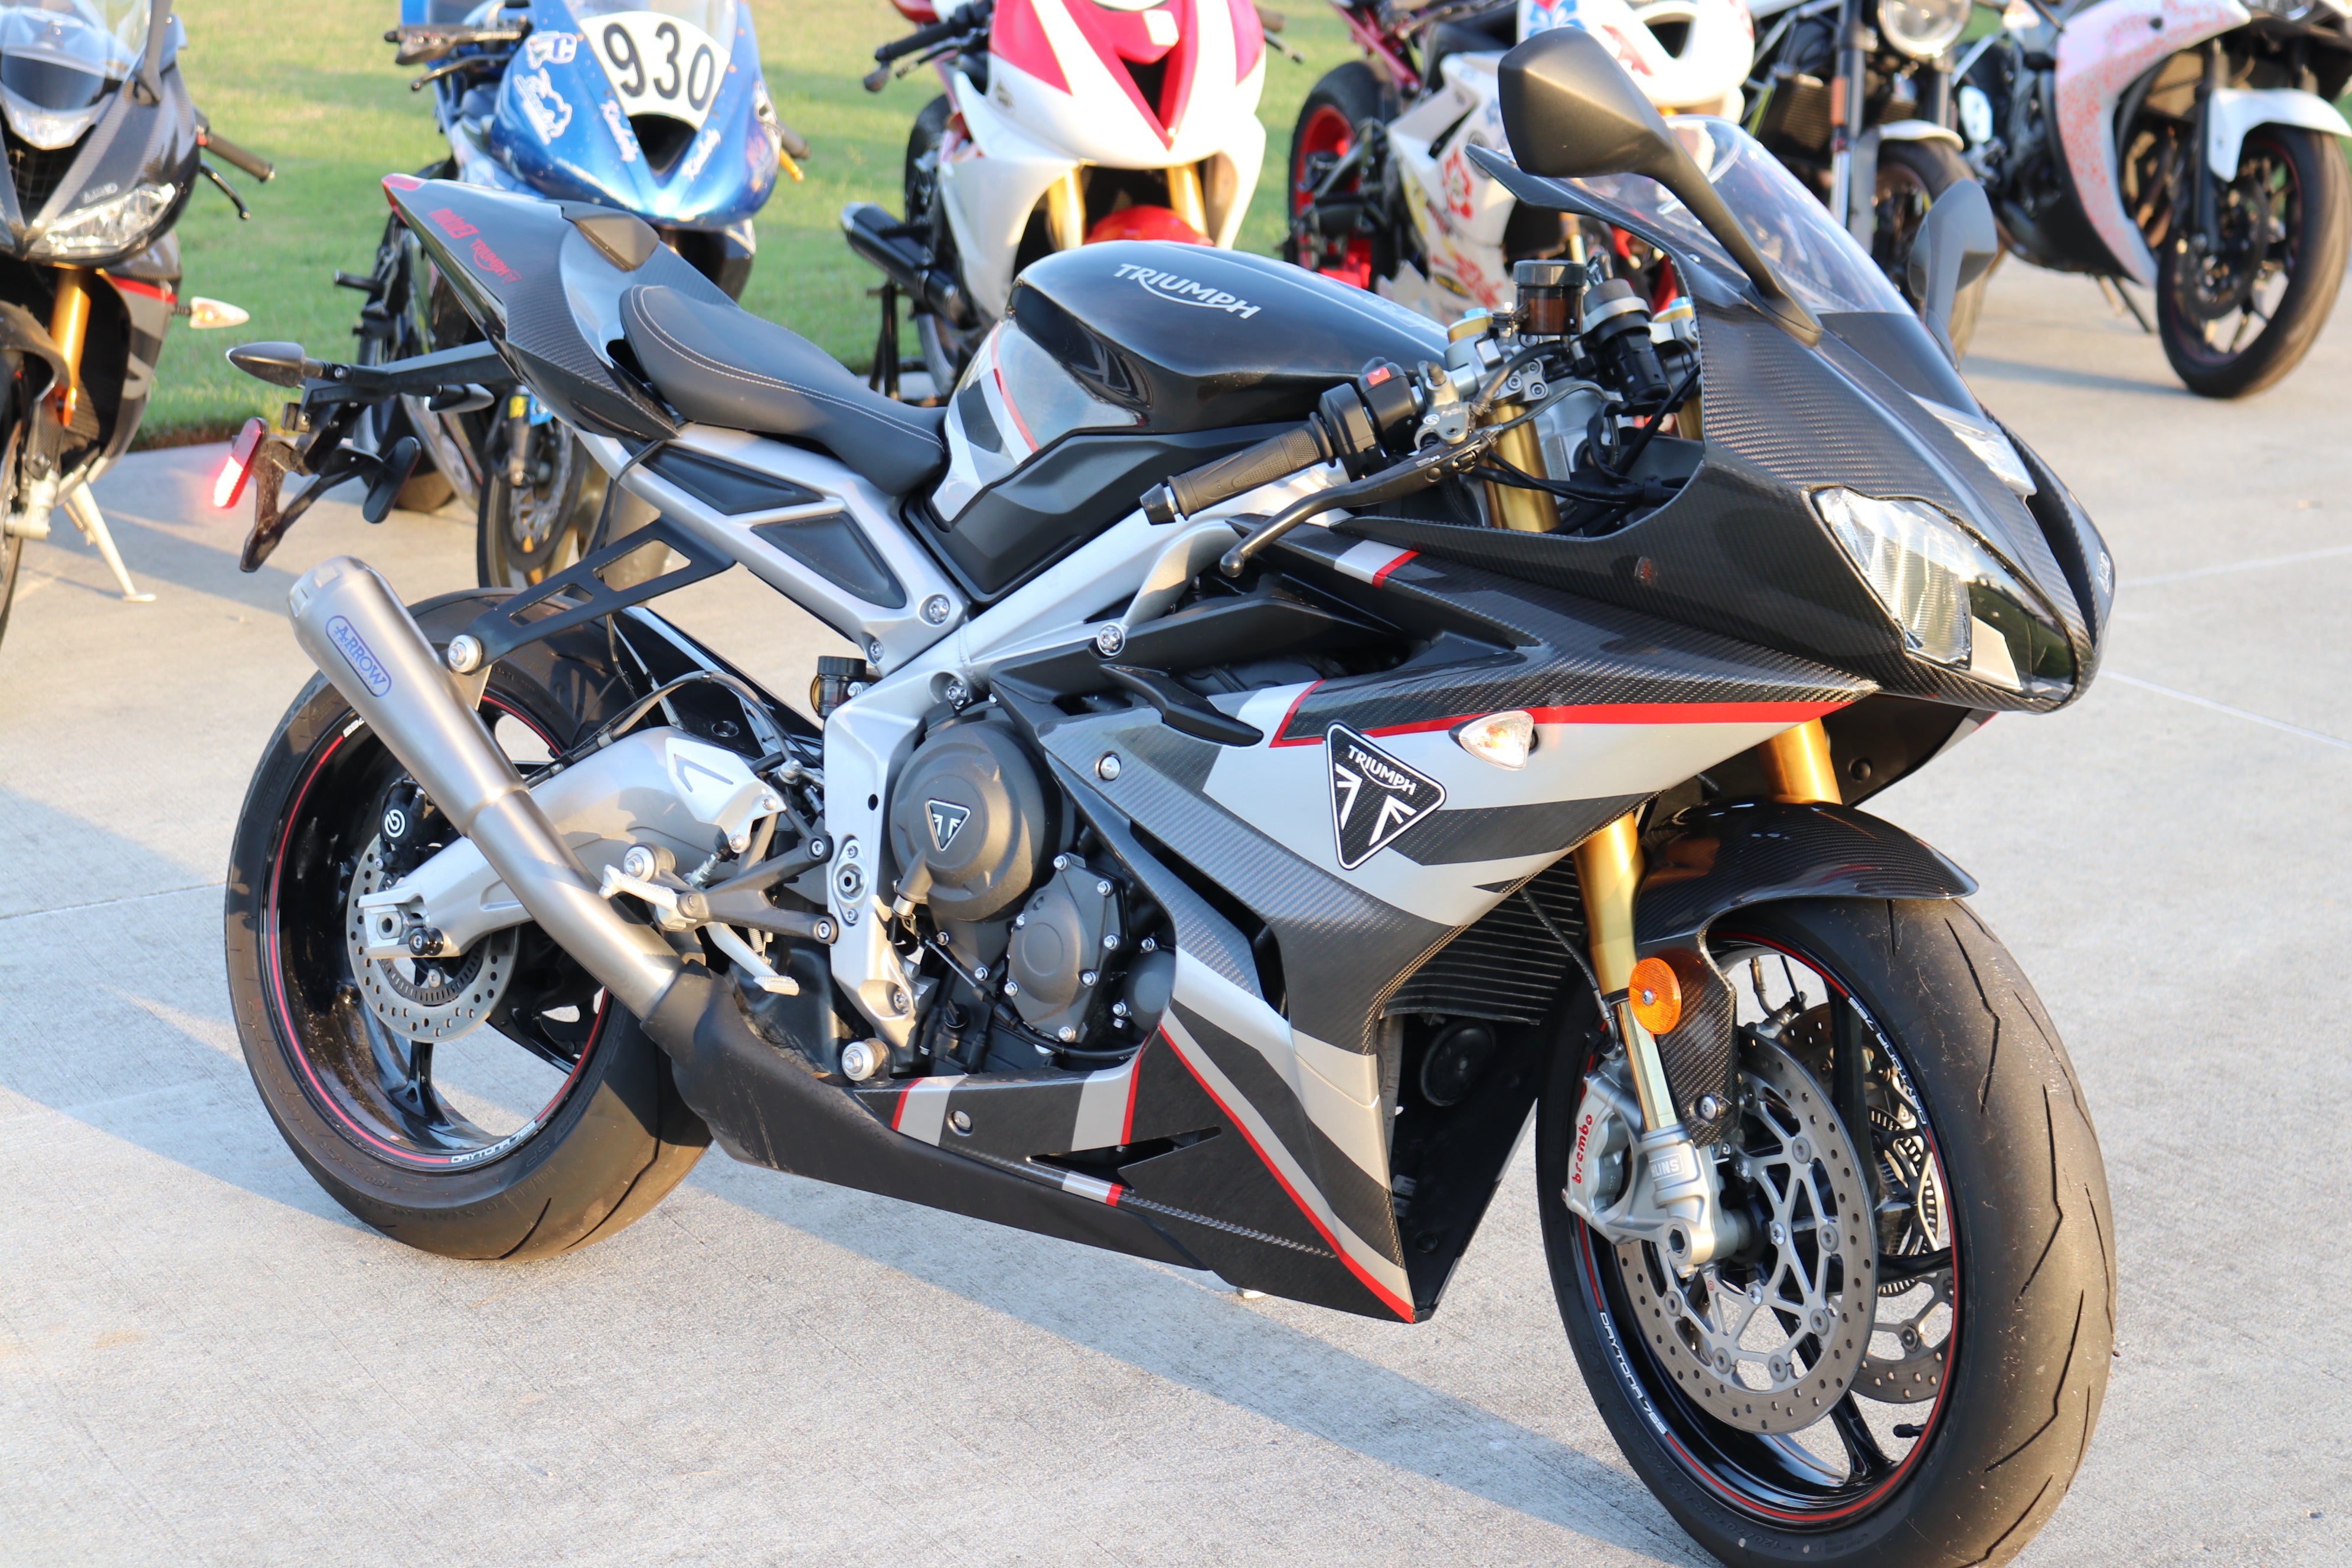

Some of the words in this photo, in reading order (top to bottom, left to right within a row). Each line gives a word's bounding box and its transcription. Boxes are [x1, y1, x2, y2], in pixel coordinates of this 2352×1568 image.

[603, 22, 716, 111] 930
[470, 239, 511, 277] TRIUMPH
[1114, 263, 1262, 319] TRIUMPH
[334, 626, 387, 685] ARROW
[1348, 744, 1417, 796] TRIUMPH
[1848, 997, 1874, 1031] 765
[450, 1139, 511, 1164] DAYTONA
[511, 1120, 537, 1141] 765
[1572, 1114, 1593, 1184] brembo
[1650, 1159, 1680, 1178] HLINS
[1599, 1312, 1643, 1399] DAYTONA
[1644, 1401, 1668, 1435] 765
[1693, 1500, 1719, 1518] ZR
[1725, 1521, 1780, 1549] 120/70
